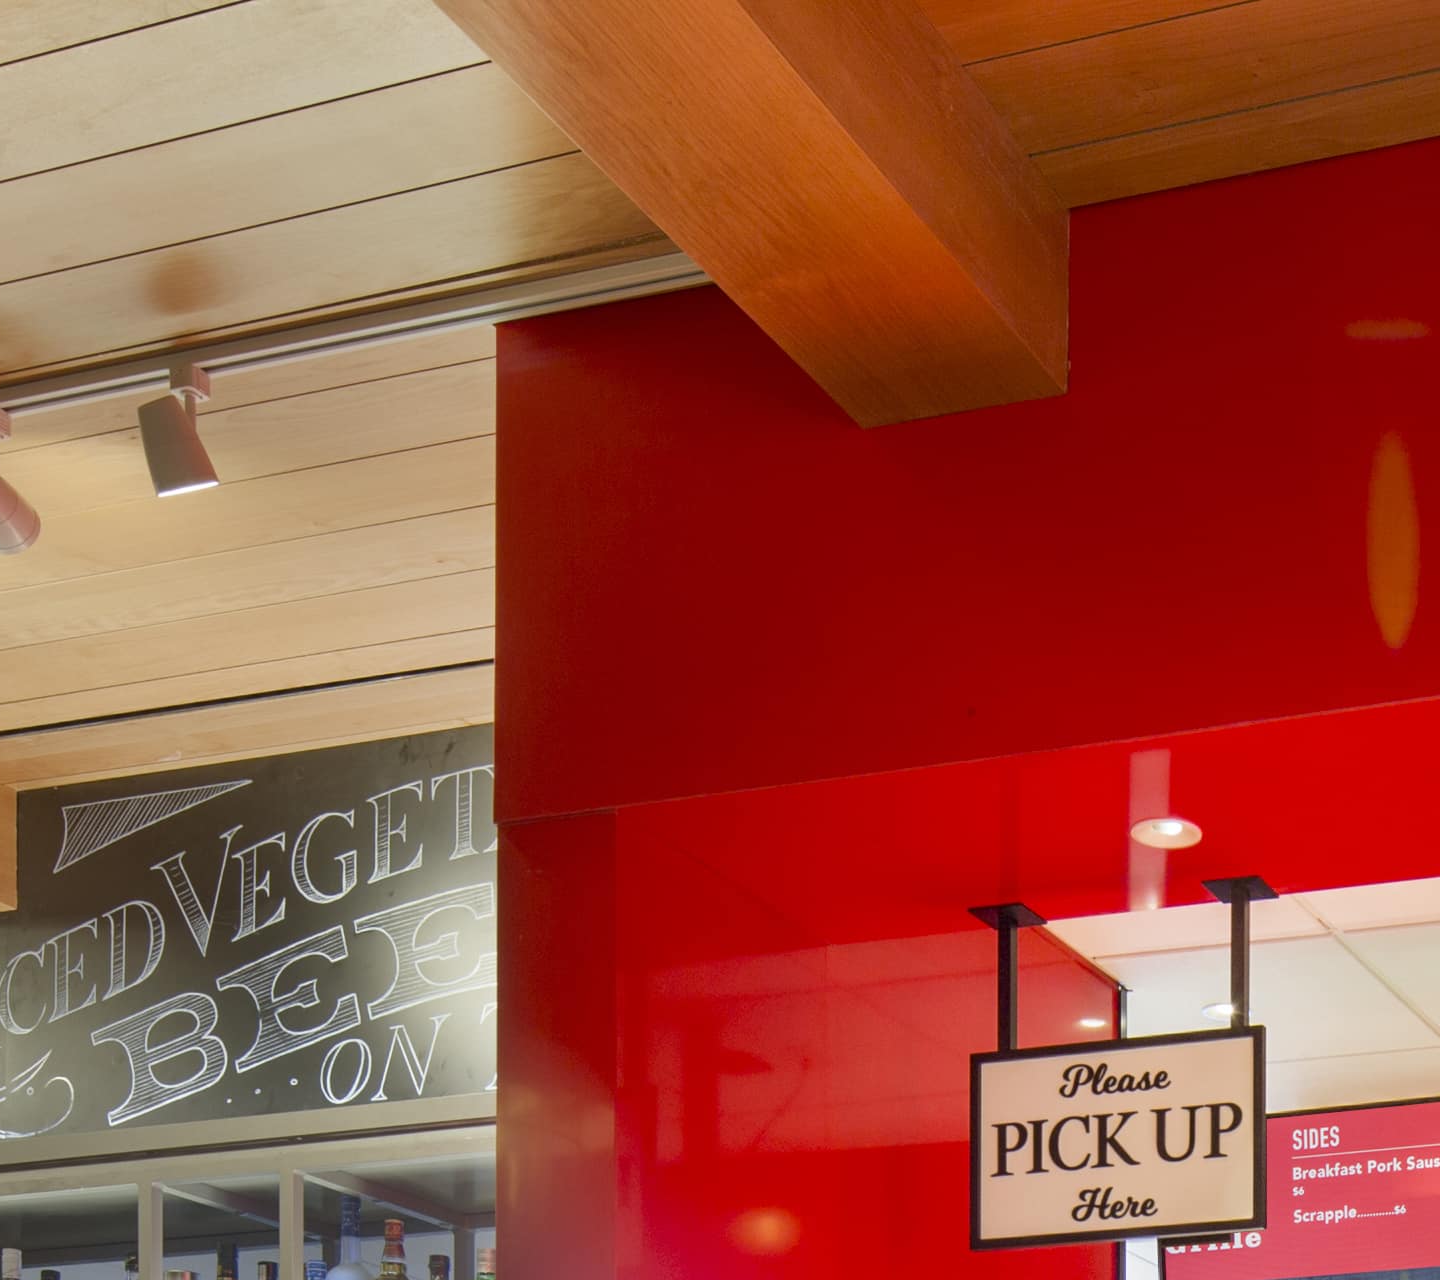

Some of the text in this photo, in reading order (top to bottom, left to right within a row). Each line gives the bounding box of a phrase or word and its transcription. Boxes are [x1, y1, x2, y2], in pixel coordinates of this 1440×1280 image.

[152, 762, 498, 956] VEGET
[1059, 1062, 1171, 1098] Please
[990, 1102, 1243, 1178] PICK UP
[1292, 1126, 1340, 1150] SIDES
[1292, 1162, 1362, 1181] Breakfast
[1368, 1158, 1402, 1174] Pork
[1071, 1188, 1158, 1223] Here
